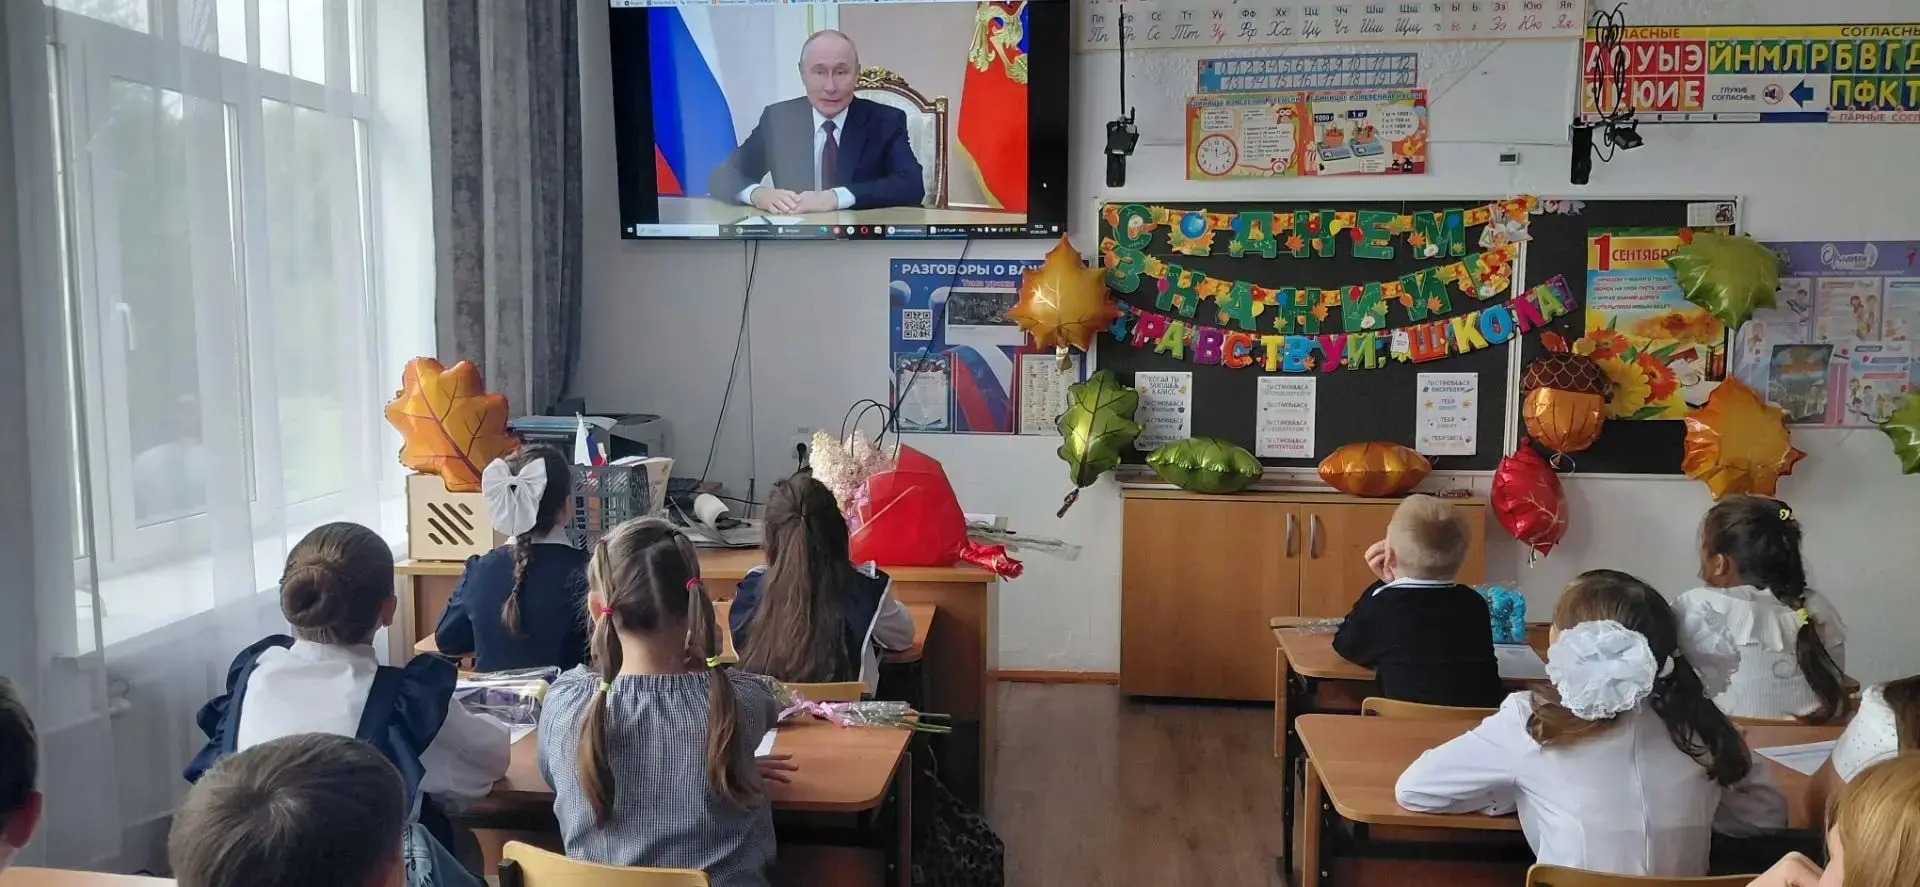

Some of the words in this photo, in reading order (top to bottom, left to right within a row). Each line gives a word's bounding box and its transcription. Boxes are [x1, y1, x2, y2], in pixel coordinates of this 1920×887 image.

[1615, 27, 1680, 38] ЛАСНЫЕ
[1220, 62, 1226, 74] 0
[1234, 61, 1240, 74] 1
[1246, 60, 1252, 74] 2
[1258, 60, 1266, 74] 3
[1268, 60, 1277, 73] 4
[1283, 60, 1290, 72] 5
[1296, 58, 1304, 72] 6
[1310, 58, 1317, 72] 7
[1322, 58, 1330, 72] 8
[1336, 58, 1342, 71] 9
[1348, 56, 1361, 71] 10
[1372, 56, 1384, 70] 11
[1398, 56, 1410, 70] 12
[1225, 76, 1239, 90] 13
[1250, 76, 1264, 90] 14
[1274, 75, 1288, 88] 15
[1298, 74, 1310, 88] 16
[1322, 74, 1336, 88] 17
[1350, 72, 1360, 87] 18
[1372, 72, 1384, 87] 19
[1396, 72, 1409, 86] 20
[1840, 114, 1886, 122] ПАРНЫЕ
[1112, 204, 1154, 250] С
[1594, 233, 1611, 271] 1
[902, 264, 990, 276] РАЗГОВОРЫ
[994, 264, 1004, 276] О
[1109, 300, 1387, 372] РАВСТВУЙ,
